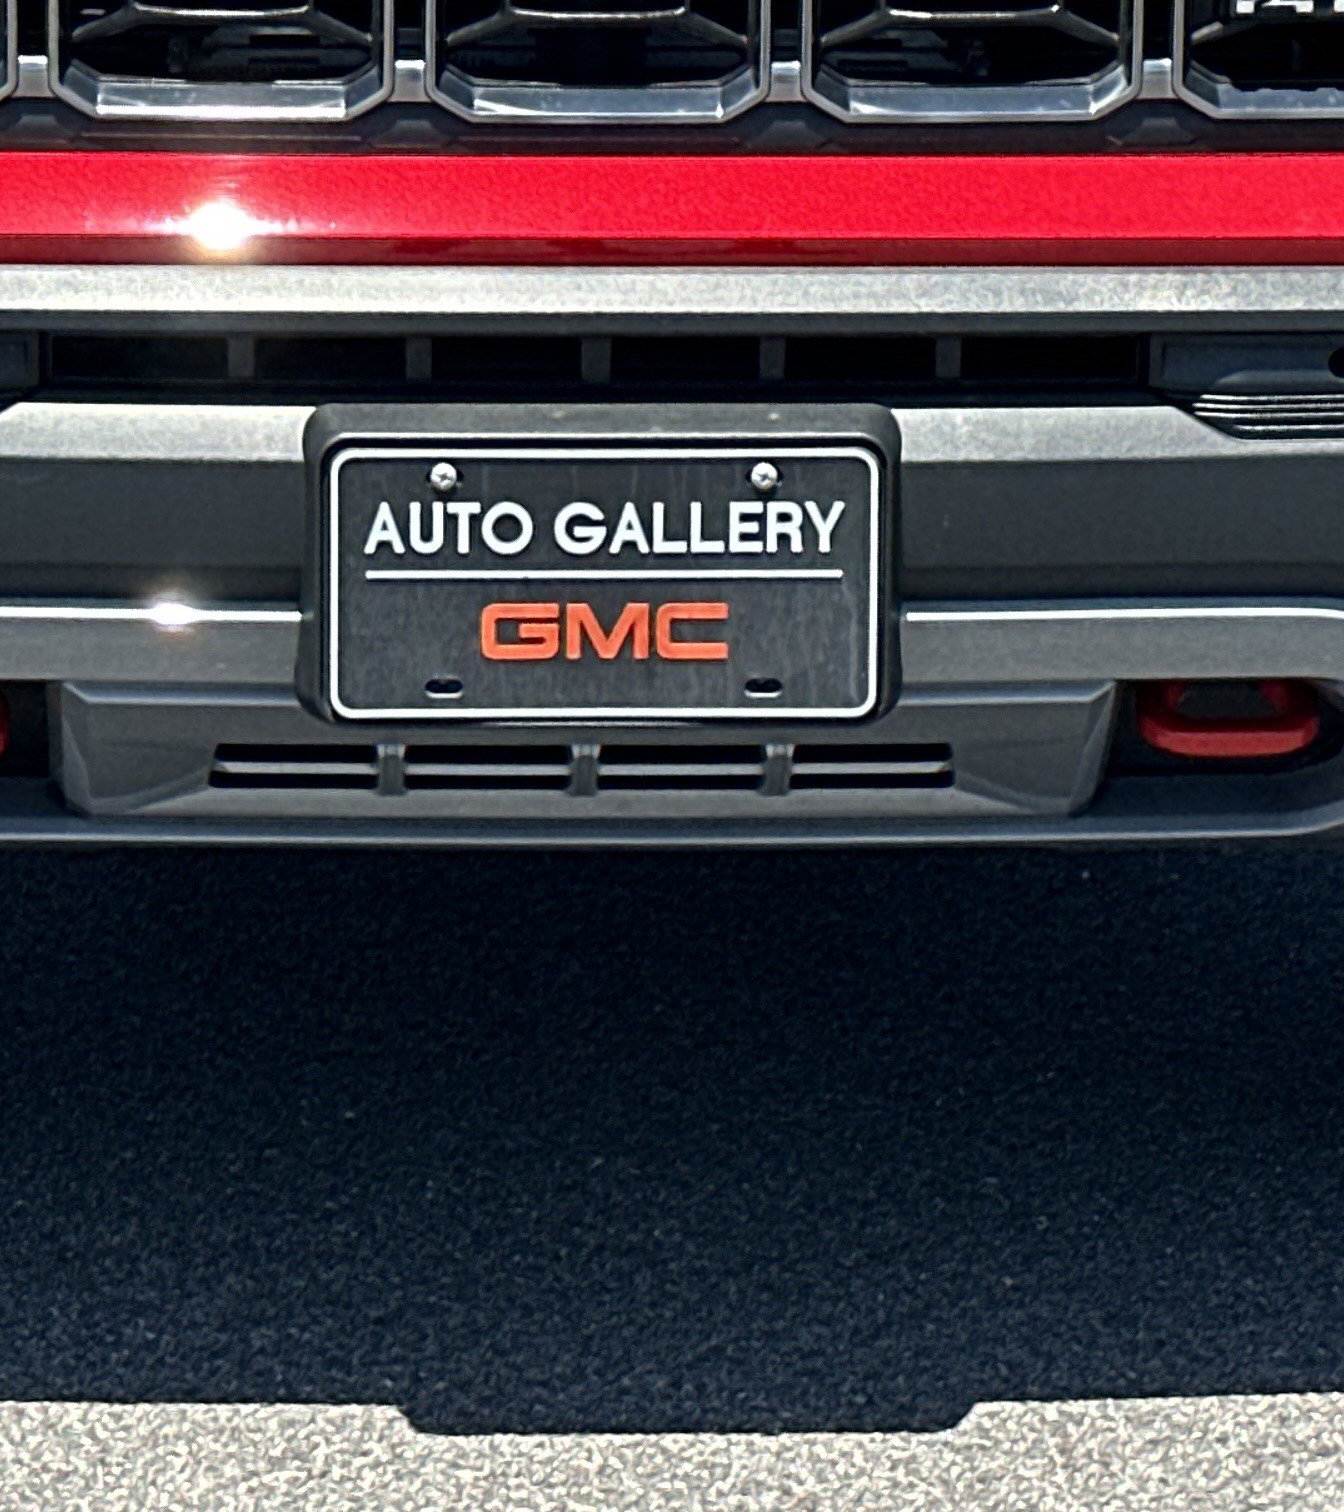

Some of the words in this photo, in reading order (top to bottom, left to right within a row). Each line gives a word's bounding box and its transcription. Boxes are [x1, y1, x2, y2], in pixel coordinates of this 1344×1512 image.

[363, 500, 534, 555] AUTO
[554, 499, 846, 555] GALLERY
[480, 600, 730, 661] GMC
